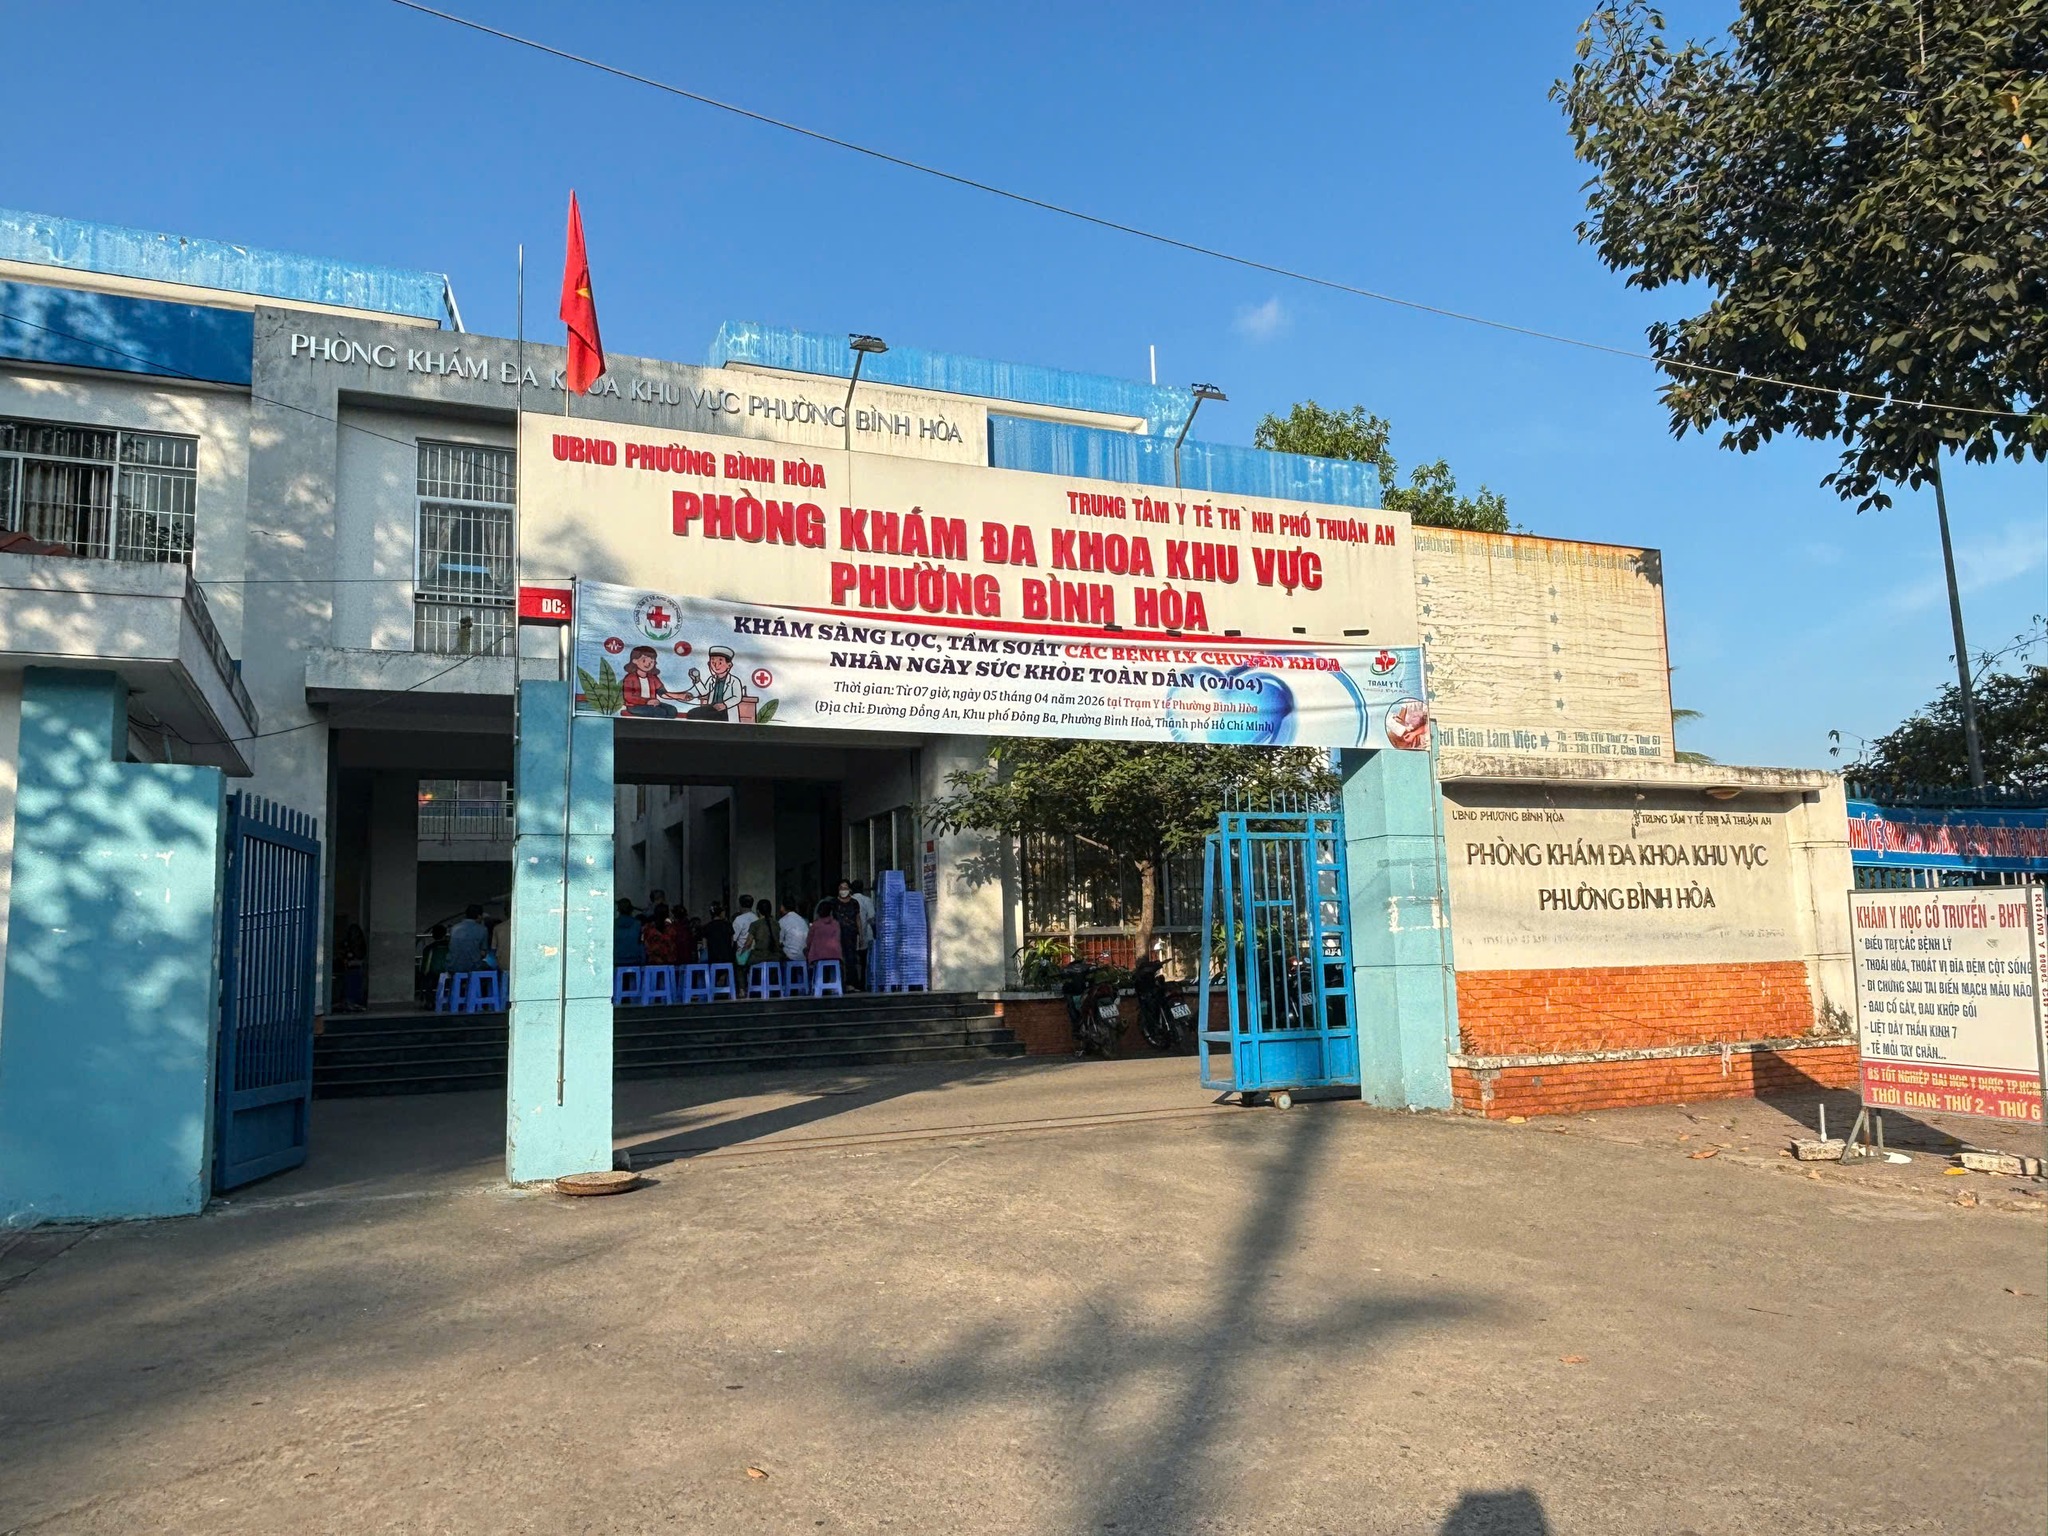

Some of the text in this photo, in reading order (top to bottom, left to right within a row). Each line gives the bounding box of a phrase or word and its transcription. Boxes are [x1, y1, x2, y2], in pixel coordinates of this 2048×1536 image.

[291, 332, 963, 443] PHÒNG KHÁM ĐA KHU VỰC PHƯỜNG BÌNH HÒA
[552, 434, 826, 489] UBND PHƯỜNG BÌNH HÒA
[1067, 491, 1126, 520] TRUNG
[1132, 496, 1170, 524] TÂM
[1175, 502, 1186, 525] Y
[1280, 510, 1310, 538] PHỐ
[1316, 518, 1369, 546] THUẬN
[1375, 525, 1395, 546] AN
[672, 487, 1322, 596] PHÒNG KHÁM ĐA KHOA KHU VỰC
[831, 561, 1208, 631] PHƯỜNG BÌNH HÒA
[734, 616, 814, 639] KHÁM
[818, 621, 886, 644] SÀNG
[890, 631, 942, 652] LỌC,
[947, 632, 1000, 653] TẦM
[1003, 639, 1062, 657] SOÁT
[1064, 642, 1107, 659] CÁC
[1112, 646, 1171, 664] BỆNH
[1288, 656, 1341, 672] KHOA
[830, 650, 1263, 694] NHÂN NGÀY SỨC KHỎE TOÀN DÂN (07/04)
[815, 700, 841, 715] (Địa
[843, 701, 865, 714] chỉ:
[867, 703, 907, 718] Đường
[909, 704, 940, 720] Đồng
[942, 708, 960, 720] An,
[963, 709, 985, 720] Khu
[987, 708, 1011, 723] phố
[1043, 713, 1058, 724] Ba,
[1061, 713, 1101, 727] Phường
[1104, 715, 1128, 726] Bình
[1155, 717, 1188, 729] Thành
[1190, 717, 1210, 731] phố
[1227, 719, 1243, 730] Chí
[834, 681, 861, 694] Thời
[863, 683, 894, 696] gian:
[896, 684, 913, 696] Từ
[914, 686, 928, 697] 07
[929, 686, 950, 700] giờ,
[953, 688, 981, 702] ngày
[983, 690, 998, 700] 05
[1000, 690, 1032, 705] tháng
[1034, 692, 1048, 704] 04
[1051, 693, 1075, 705] năm
[1077, 695, 1105, 706] 2026
[1107, 697, 1121, 710] tại
[1123, 698, 1151, 711] Trạm
[1153, 700, 1160, 709] Y
[1162, 697, 1171, 710] tế
[1173, 701, 1211, 714] Phường
[1213, 702, 1236, 712] Bình
[1452, 810, 1477, 821] UBND
[1466, 836, 1768, 870] PHÒNG KHÁM ĐA KHOA KHU VỰC
[1539, 880, 1715, 911] PHƯỜNG BÌNH HÒA
[1856, 900, 1887, 929] KHÁM
[1890, 906, 1896, 929] Y
[1900, 905, 1921, 934] HỌC
[1925, 895, 1939, 929] CỔ
[1871, 1085, 1900, 1104] THỜI
[1904, 1090, 1941, 1109] GIAN:
[1944, 1093, 1972, 1112] THỨ
[1974, 1097, 1984, 1114] 2
[1998, 1099, 2027, 1119] THỨ
[2031, 1104, 2041, 1120] 6
